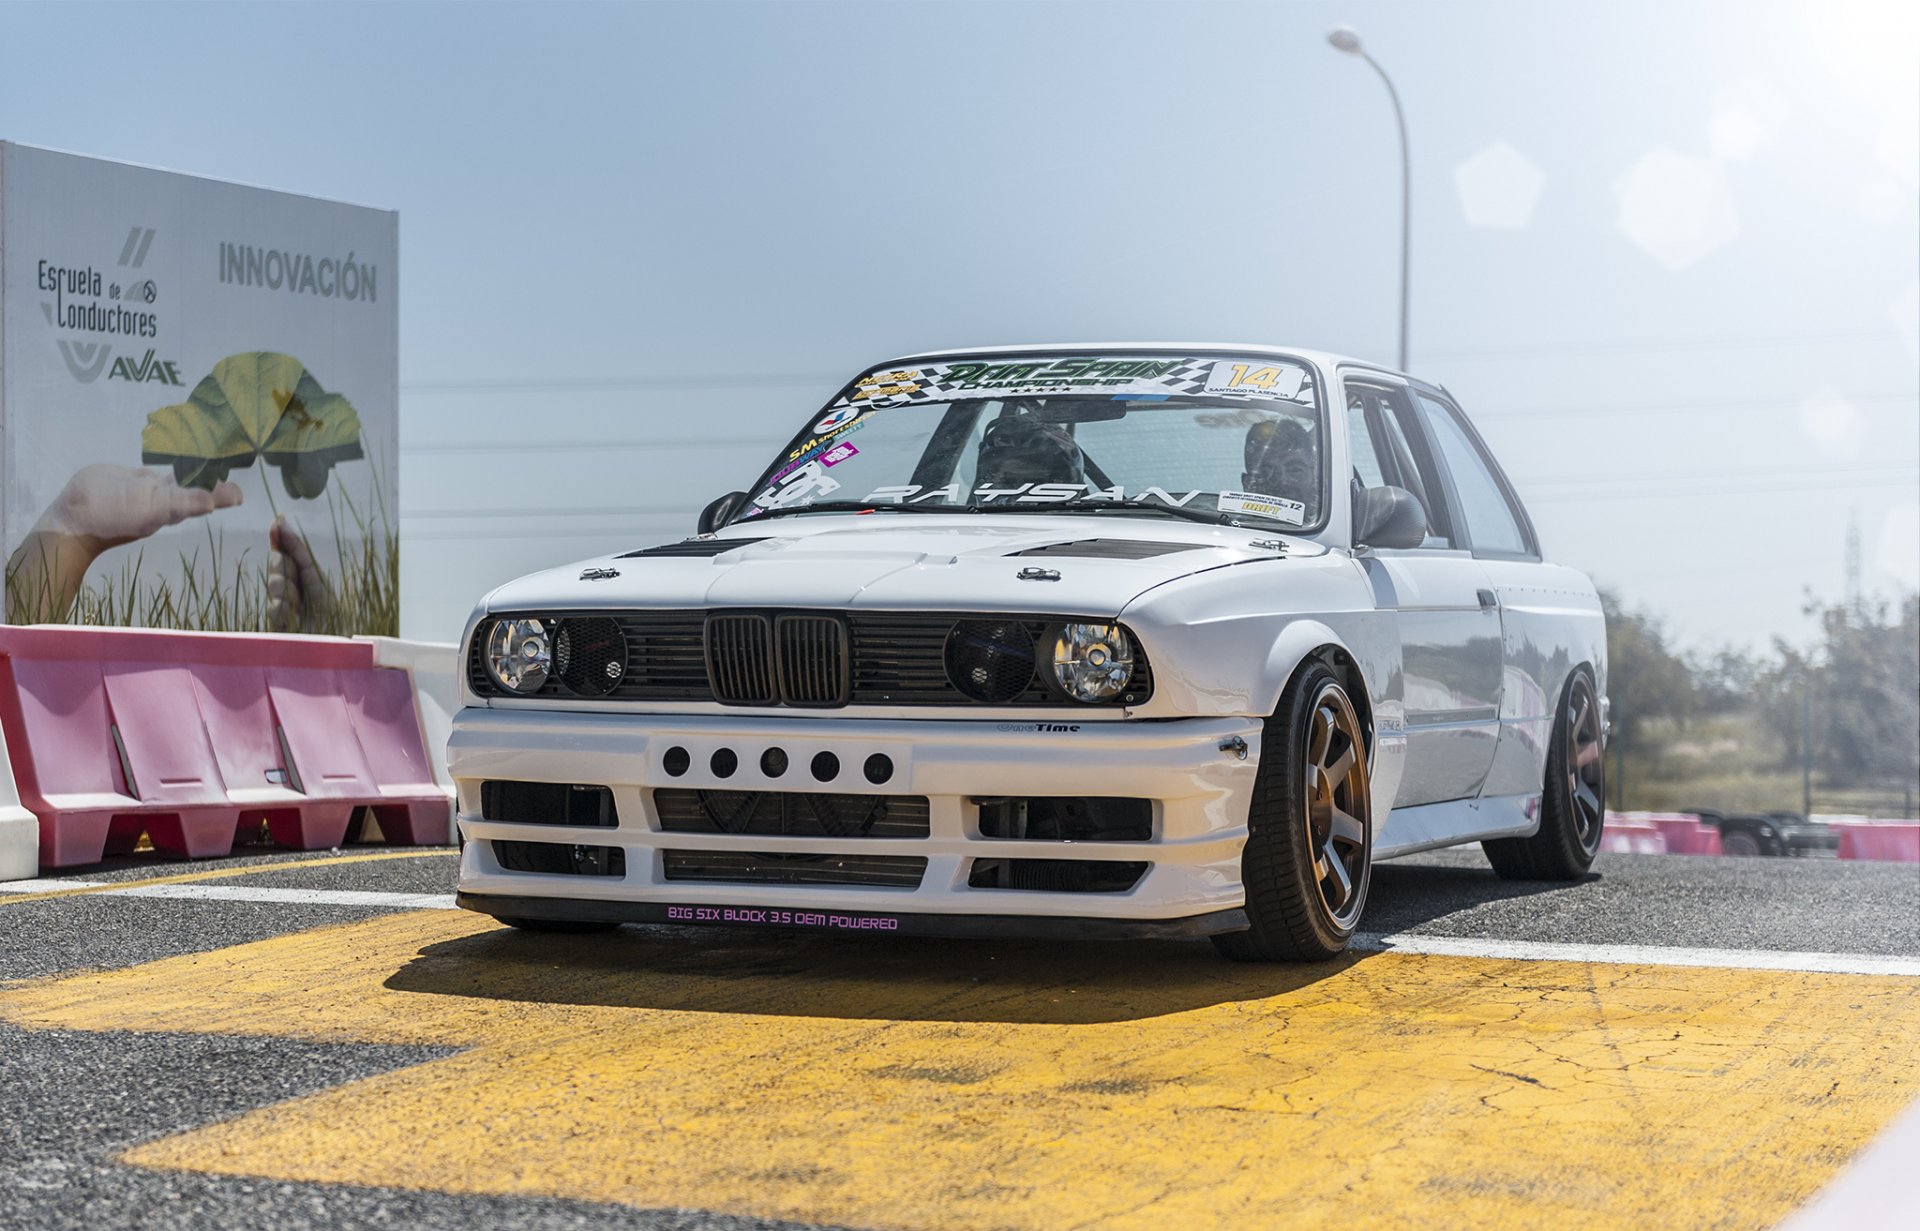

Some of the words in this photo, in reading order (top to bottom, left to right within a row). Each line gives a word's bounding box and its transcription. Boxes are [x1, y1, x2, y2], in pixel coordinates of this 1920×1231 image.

[38, 259, 102, 298] Escuela
[109, 281, 121, 300] de
[219, 241, 377, 303] INNOVACIÓN
[57, 300, 157, 338] Conductores
[957, 379, 1134, 390] CHAMPIONSHIP
[1228, 364, 1283, 389] 14
[789, 439, 818, 462] SM
[861, 482, 1201, 508] RAYSAN
[1290, 502, 1303, 511] 12
[667, 907, 693, 919] BIG
[696, 908, 720, 920] SIX
[724, 910, 766, 922] BLOCK
[770, 911, 791, 924] 3.5
[795, 913, 825, 926] OEM
[829, 915, 898, 930] POWERED
